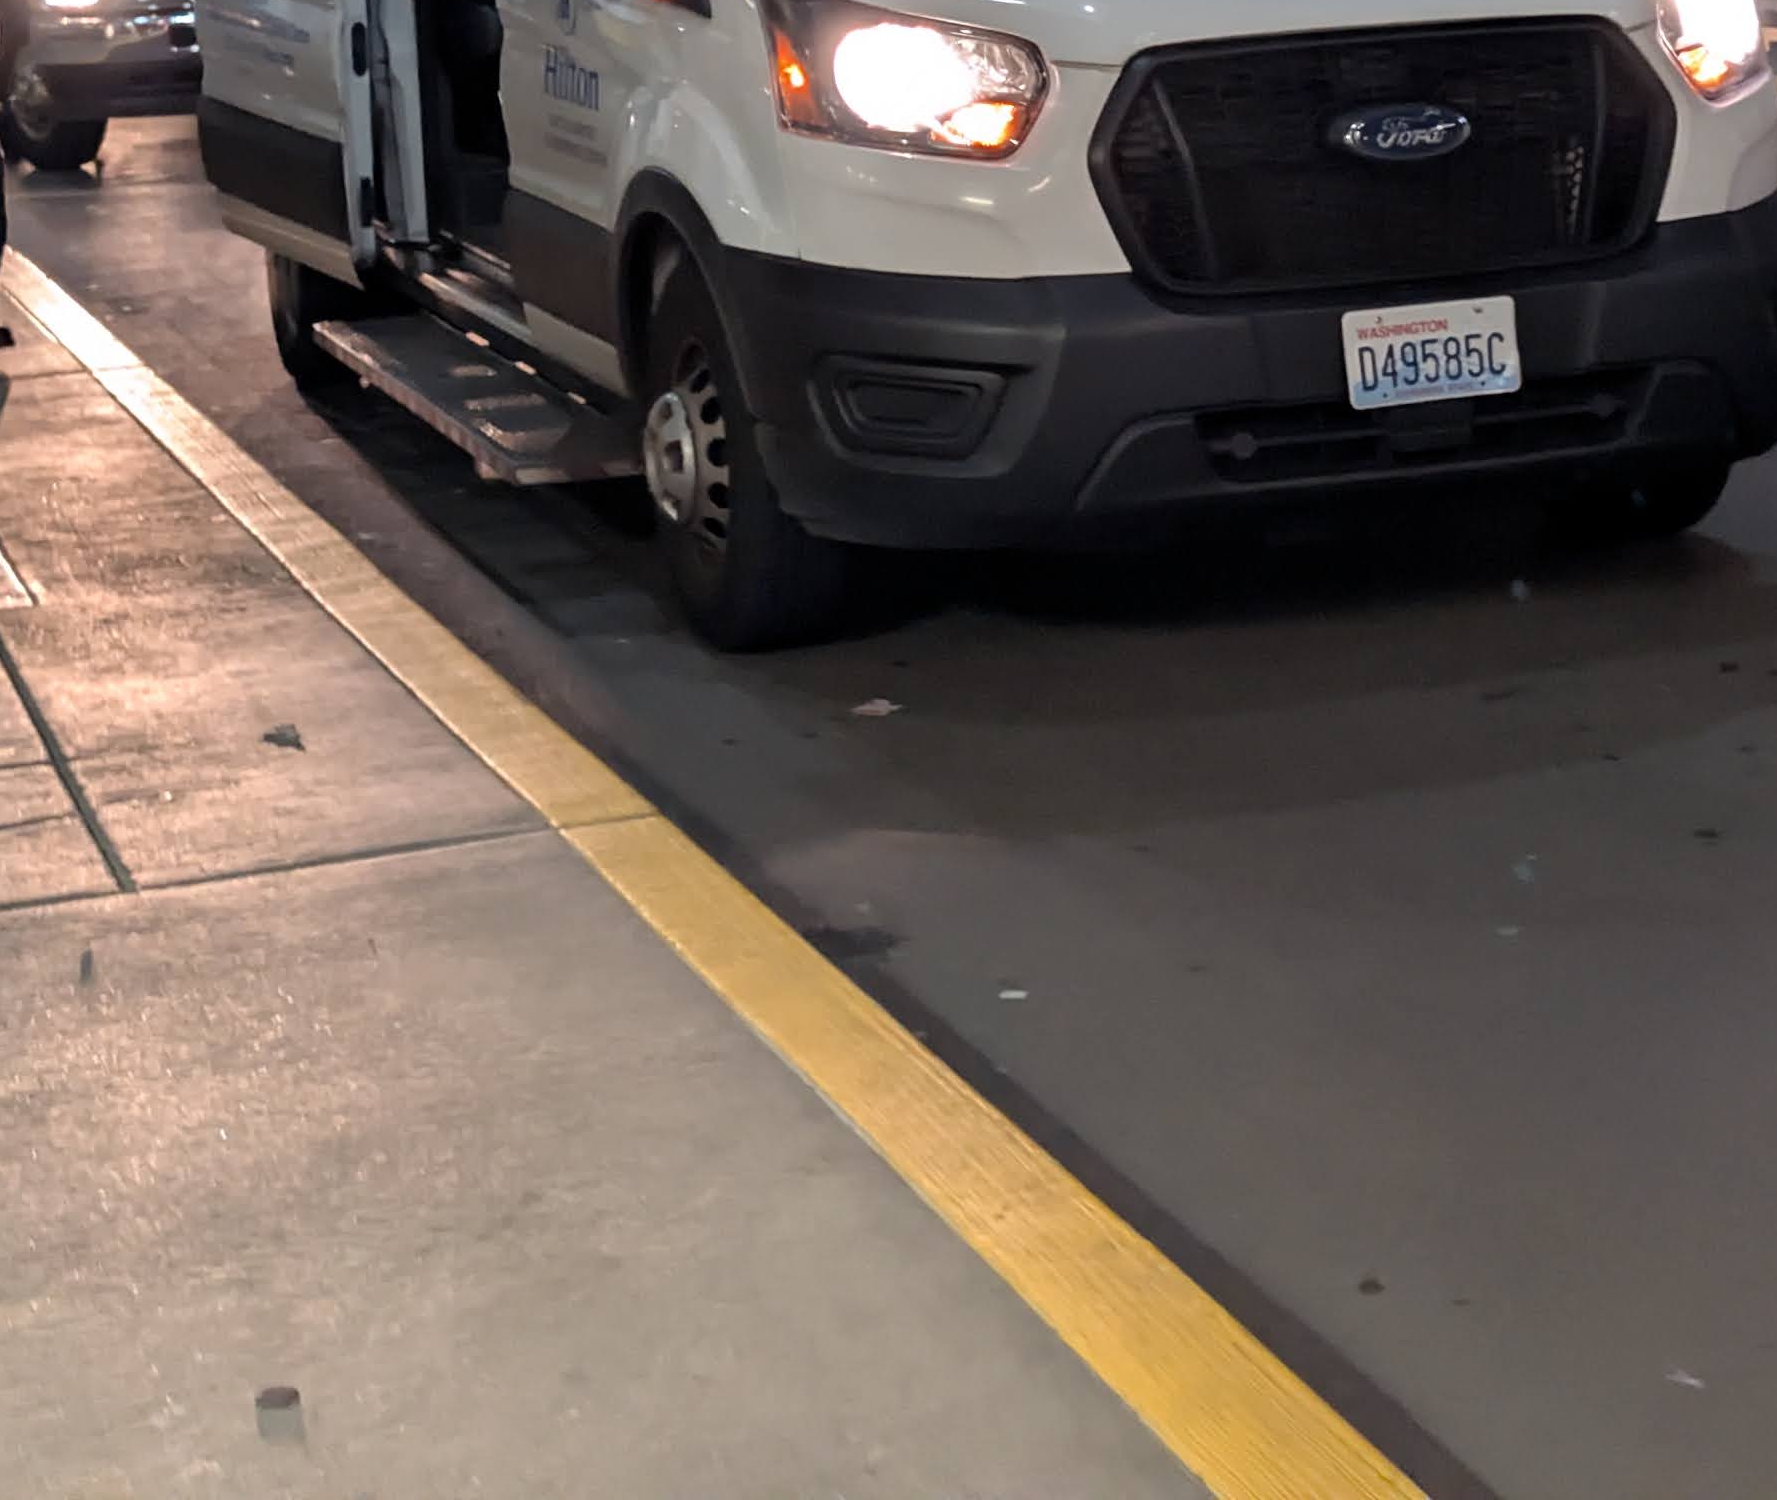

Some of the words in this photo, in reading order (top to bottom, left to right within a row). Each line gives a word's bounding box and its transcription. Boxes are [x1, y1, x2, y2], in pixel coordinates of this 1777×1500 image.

[542, 45, 601, 112] Hilton
[1376, 112, 1452, 149] Ford
[1356, 318, 1449, 341] WASHINGTON
[1357, 332, 1507, 393] D49585C
